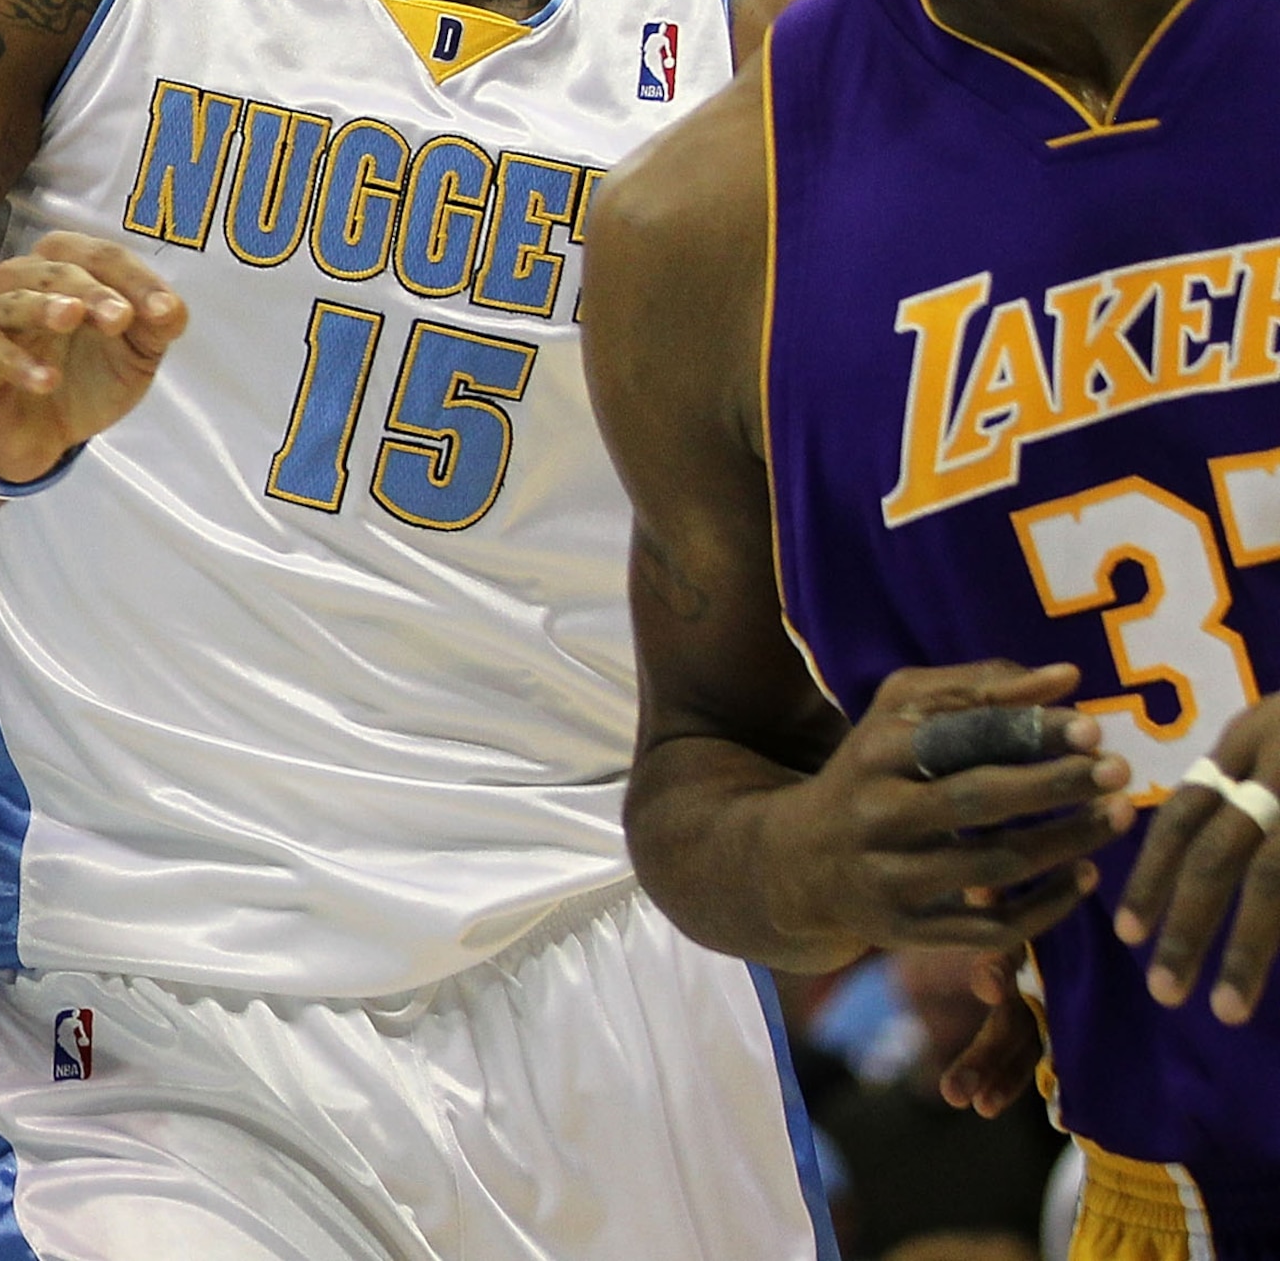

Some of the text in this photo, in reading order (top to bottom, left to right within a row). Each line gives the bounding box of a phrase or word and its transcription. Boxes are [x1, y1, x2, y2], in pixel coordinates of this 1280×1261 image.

[431, 13, 464, 63] D
[640, 84, 663, 98] NBA
[264, 298, 539, 532] 15
[55, 1063, 79, 1078] NBA
